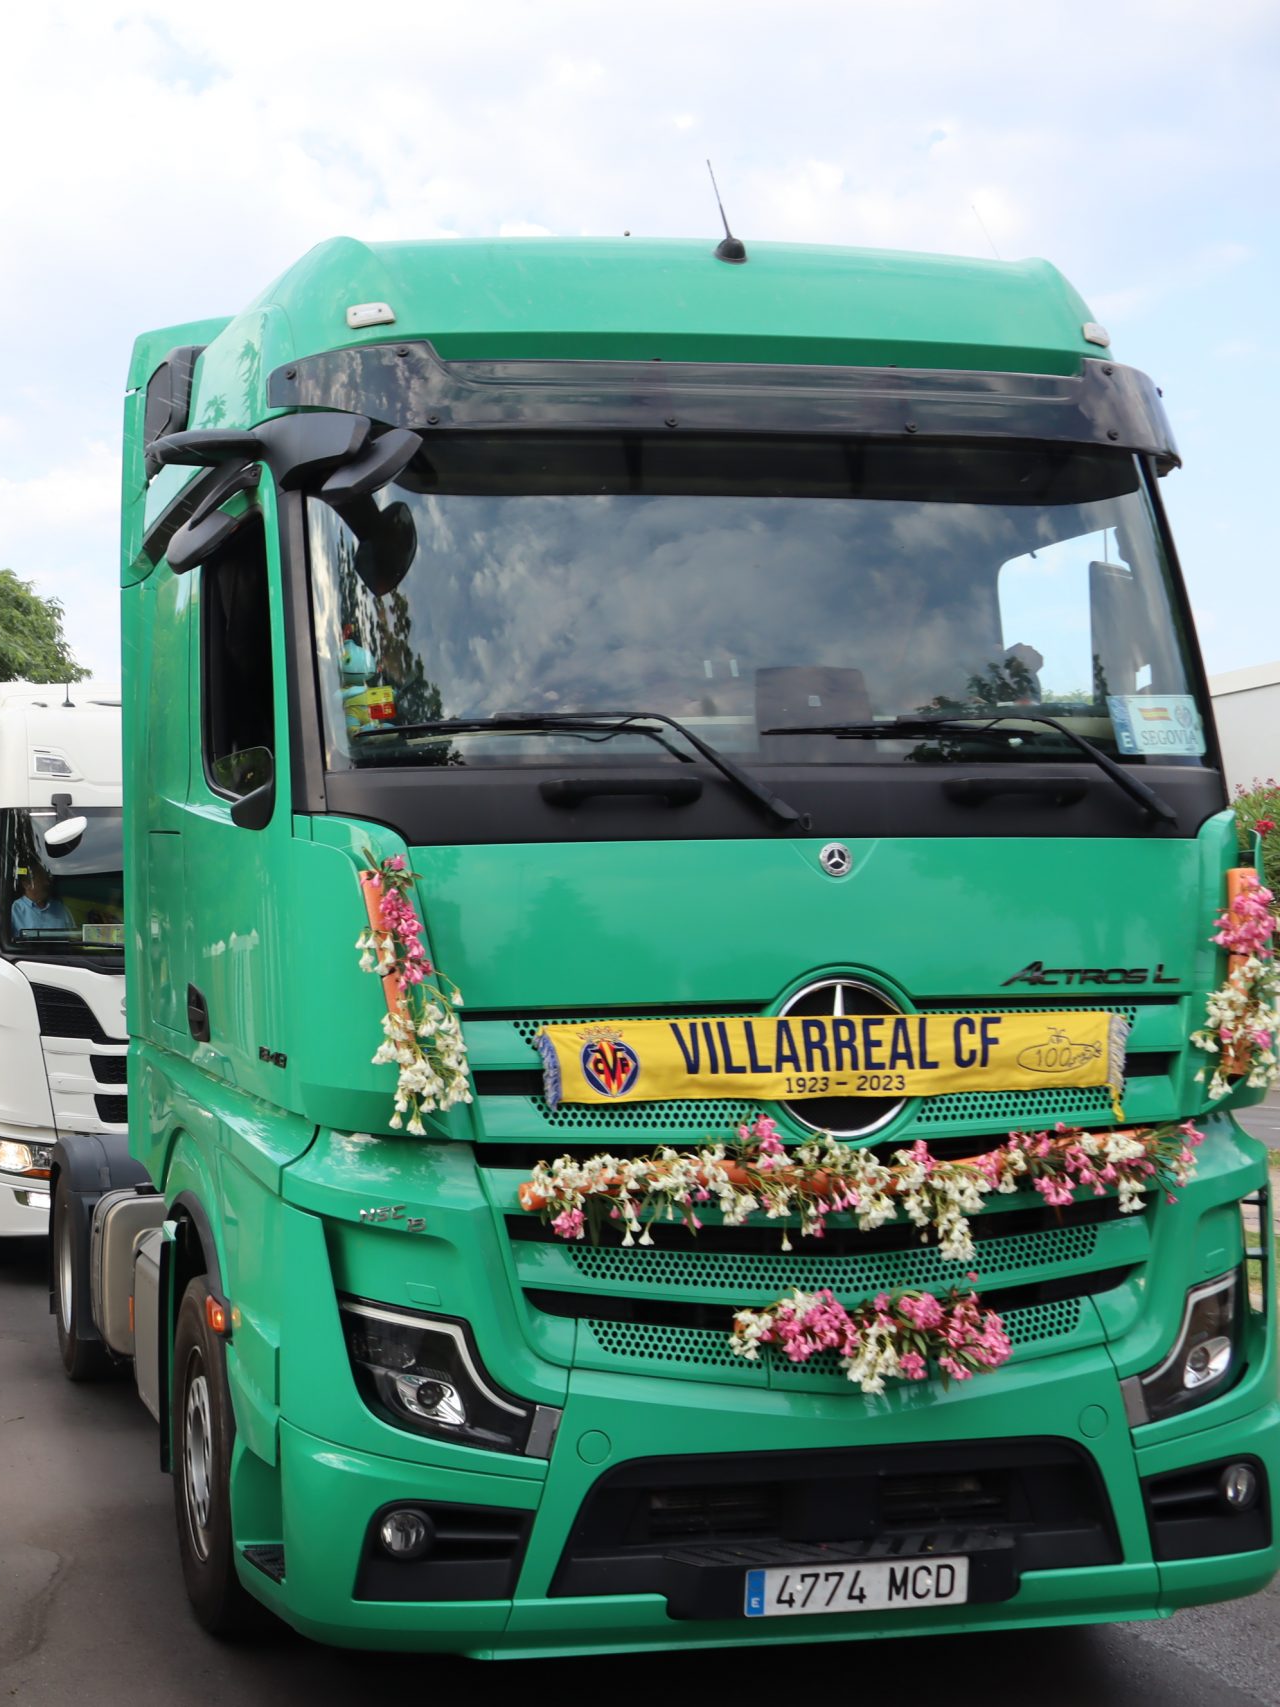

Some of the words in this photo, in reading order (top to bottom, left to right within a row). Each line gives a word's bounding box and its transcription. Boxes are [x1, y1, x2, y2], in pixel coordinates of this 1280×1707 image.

[1121, 732, 1134, 748] E
[1140, 729, 1199, 746] SEGOVIA
[1152, 963, 1181, 984] L
[670, 1017, 939, 1075] VILLARREAL
[953, 1016, 1002, 1069] CF
[785, 1076, 830, 1094] 1923
[855, 1075, 907, 1092] 2023
[750, 1597, 761, 1608] E
[776, 1570, 867, 1609] 4774
[887, 1563, 956, 1602] MCD
